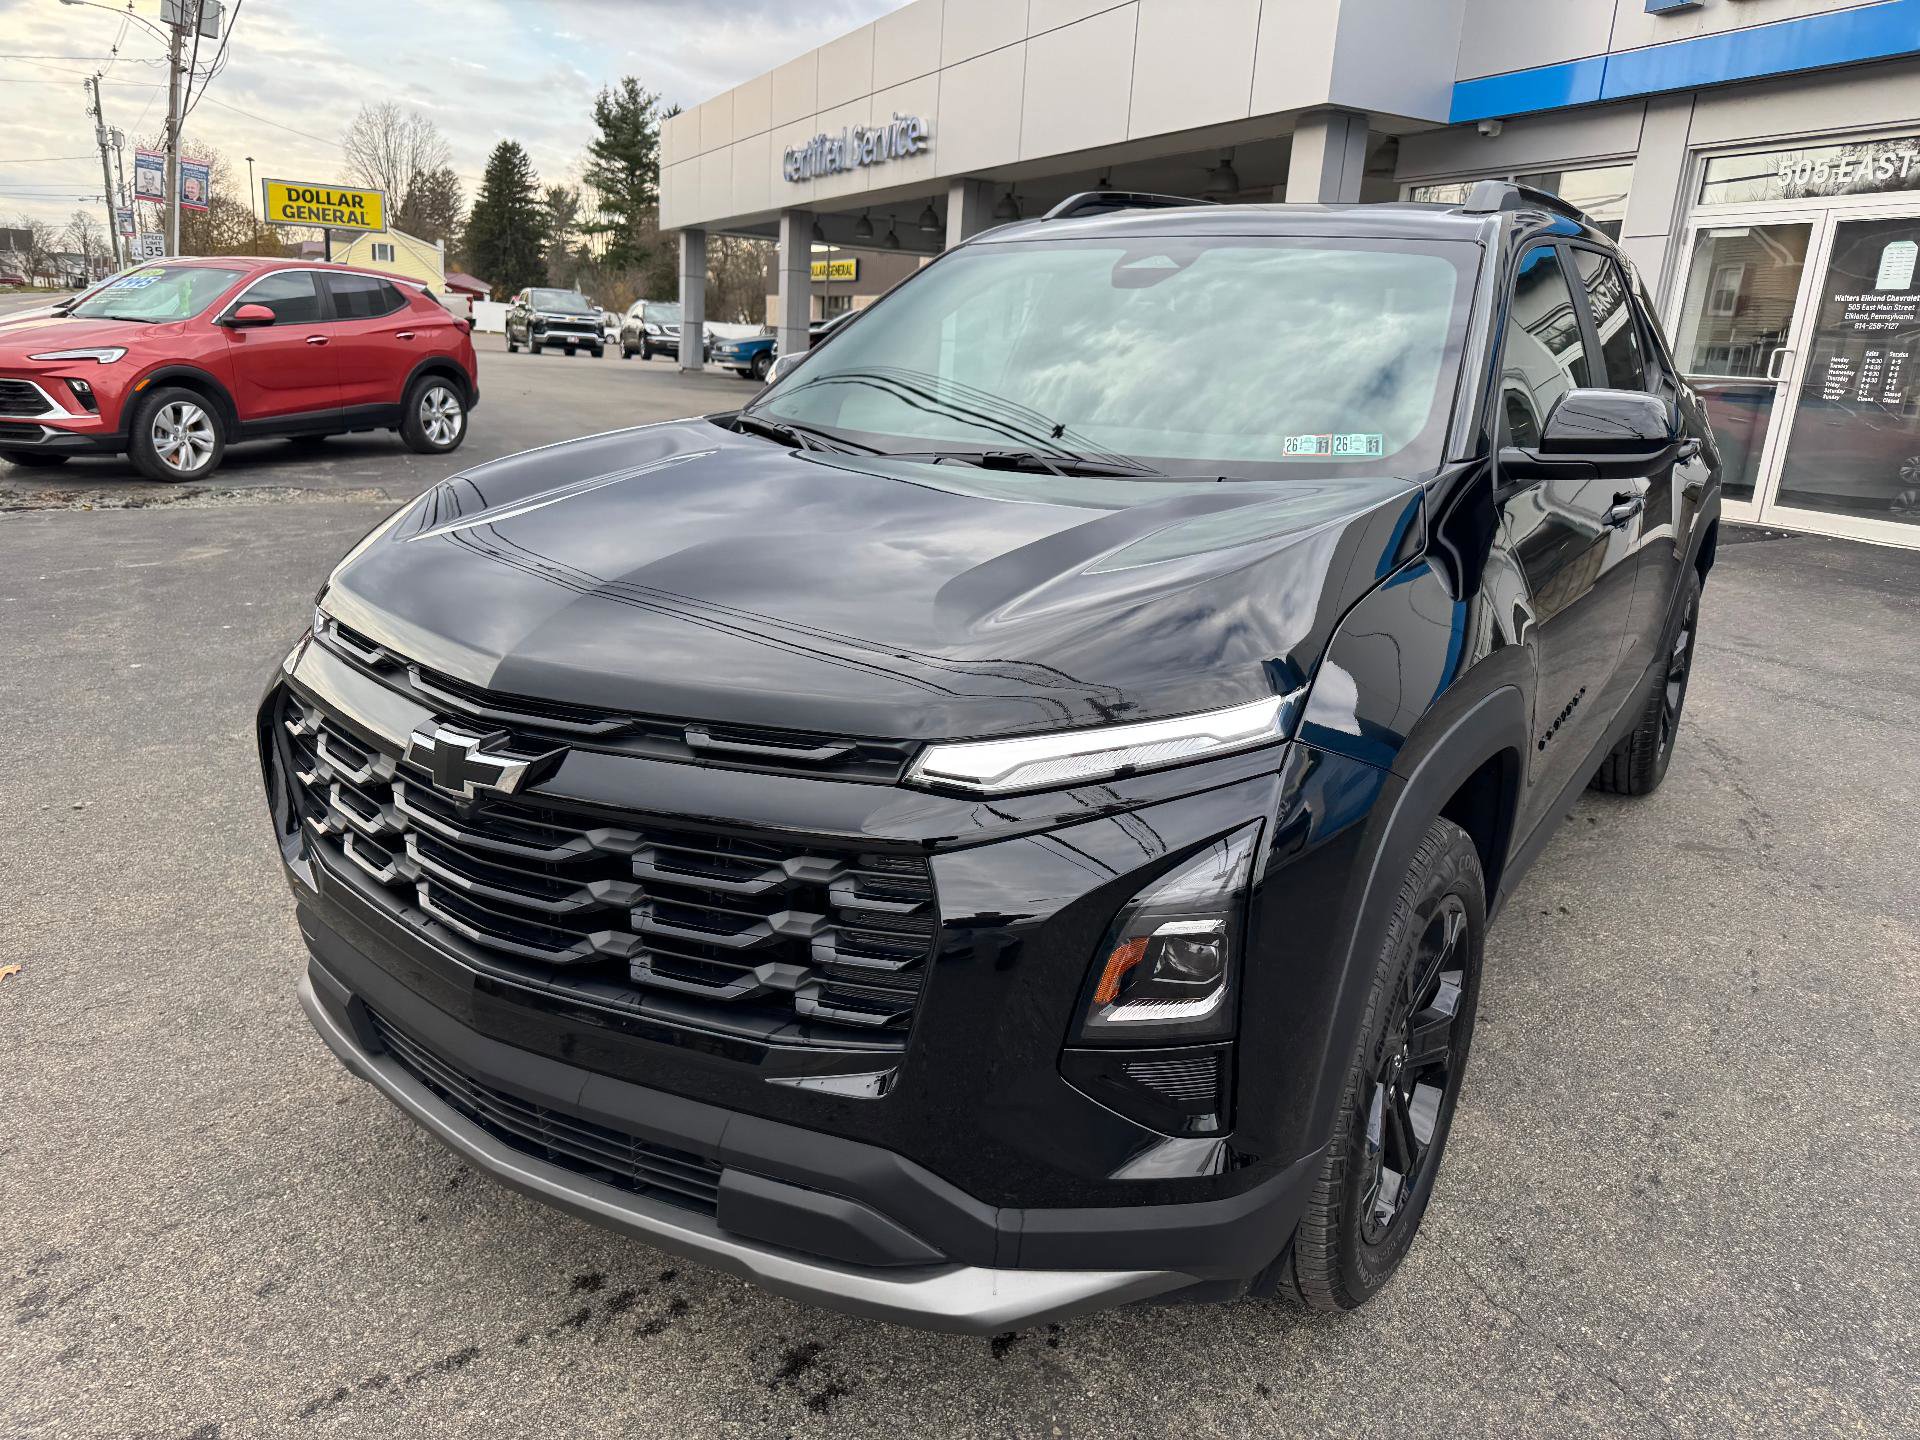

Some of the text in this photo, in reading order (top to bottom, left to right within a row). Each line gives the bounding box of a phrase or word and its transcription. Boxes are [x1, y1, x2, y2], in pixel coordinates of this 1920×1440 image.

[783, 111, 928, 182] Certified Service
[1776, 149, 1919, 187] 505 EAST
[286, 187, 364, 208] DOLLAR
[282, 205, 370, 226] GENERAL
[145, 246, 164, 257] 35
[1871, 313, 1914, 321] Pennsylvania
[1286, 438, 1298, 452] 26
[1336, 437, 1348, 451] 26
